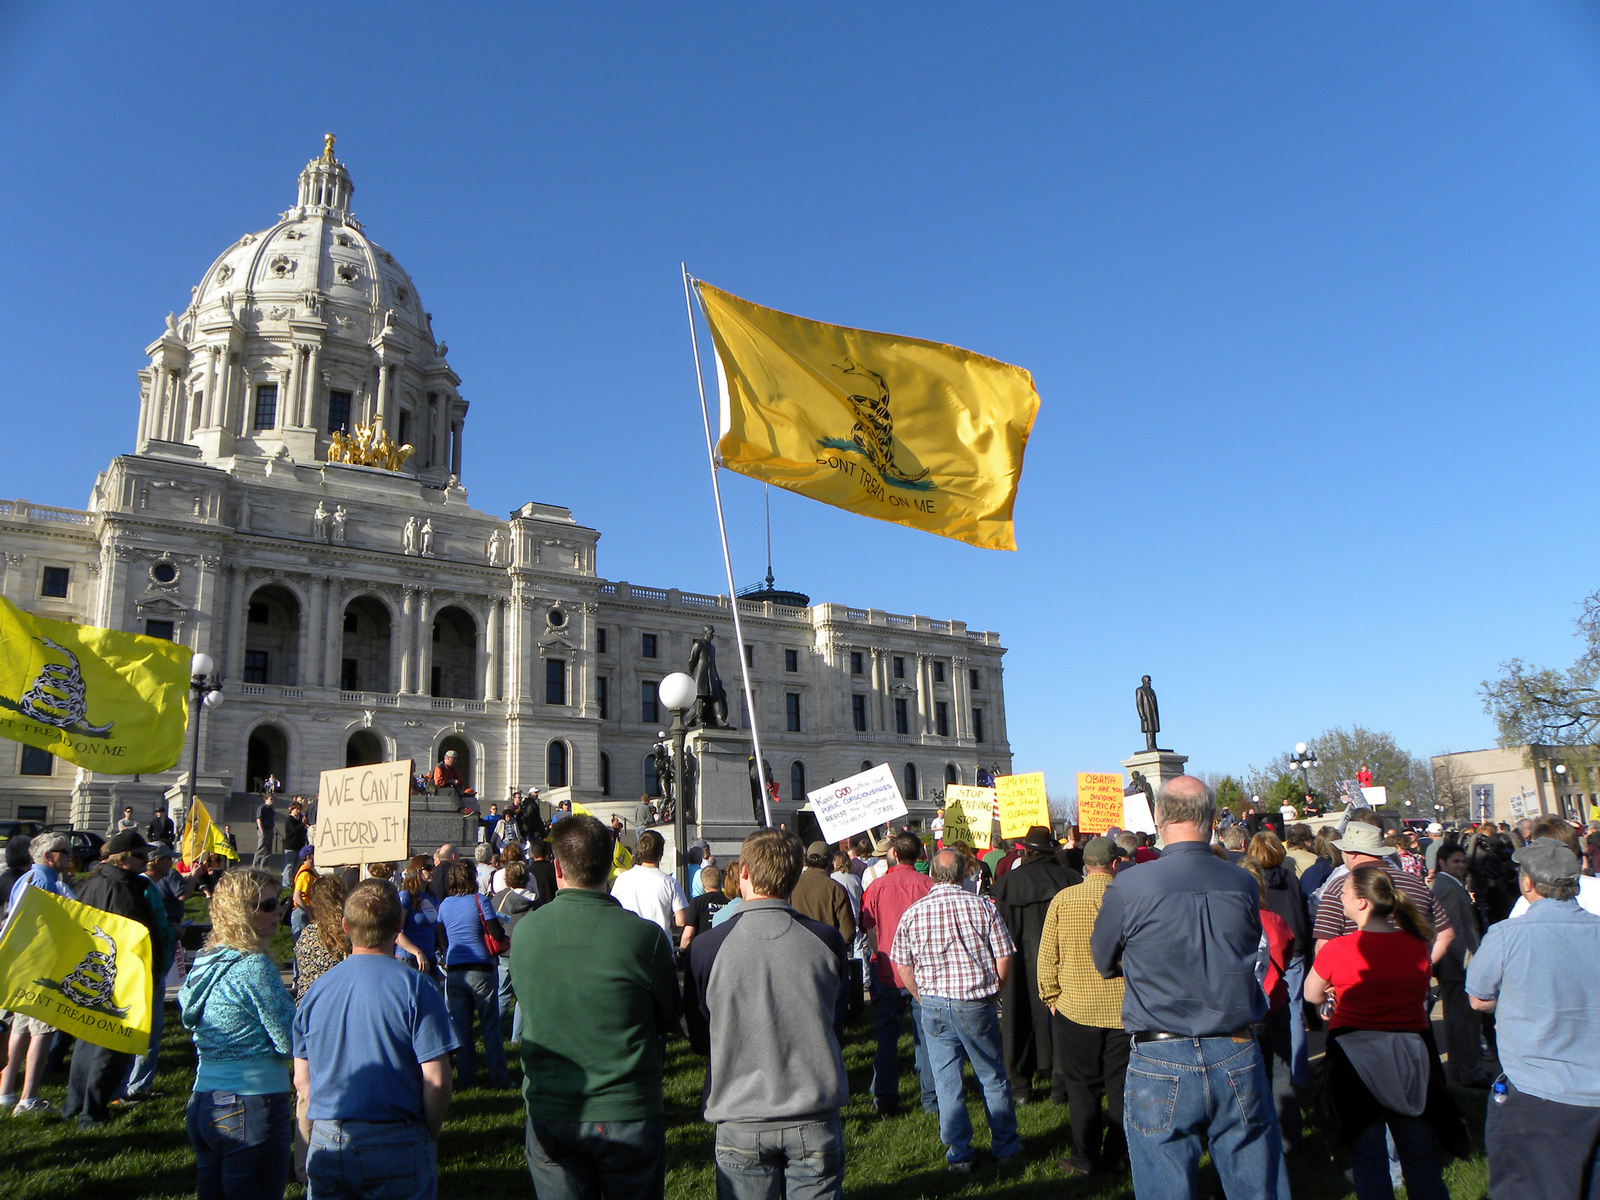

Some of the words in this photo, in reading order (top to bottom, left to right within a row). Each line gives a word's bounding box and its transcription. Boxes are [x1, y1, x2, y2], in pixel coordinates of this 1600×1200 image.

[860, 467, 885, 503] TREAD
[889, 495, 910, 508] ON
[914, 499, 936, 514] ME
[21, 723, 72, 748] TREAD
[75, 742, 100, 755] ON
[102, 745, 128, 757] ME
[1001, 775, 1040, 788] AMERICA
[1085, 774, 1115, 784] OBAMA
[325, 774, 354, 807] WE
[835, 787, 852, 799] GOD
[957, 789, 984, 798] STOP
[1012, 787, 1039, 797] UNITED
[1090, 793, 1117, 802] DIVIDING
[947, 797, 993, 812] SPENDING
[1079, 800, 1123, 812] AMERICA?
[824, 809, 848, 823] RESIST
[955, 814, 978, 825] STOP
[1007, 808, 1039, 819] OBAMA
[320, 817, 379, 847] AFFORD
[945, 825, 991, 843] TYRANNY
[14, 988, 54, 1007] DONT
[56, 1001, 96, 1026] TREAD
[97, 1018, 118, 1033] ON
[117, 1022, 135, 1038] ME
